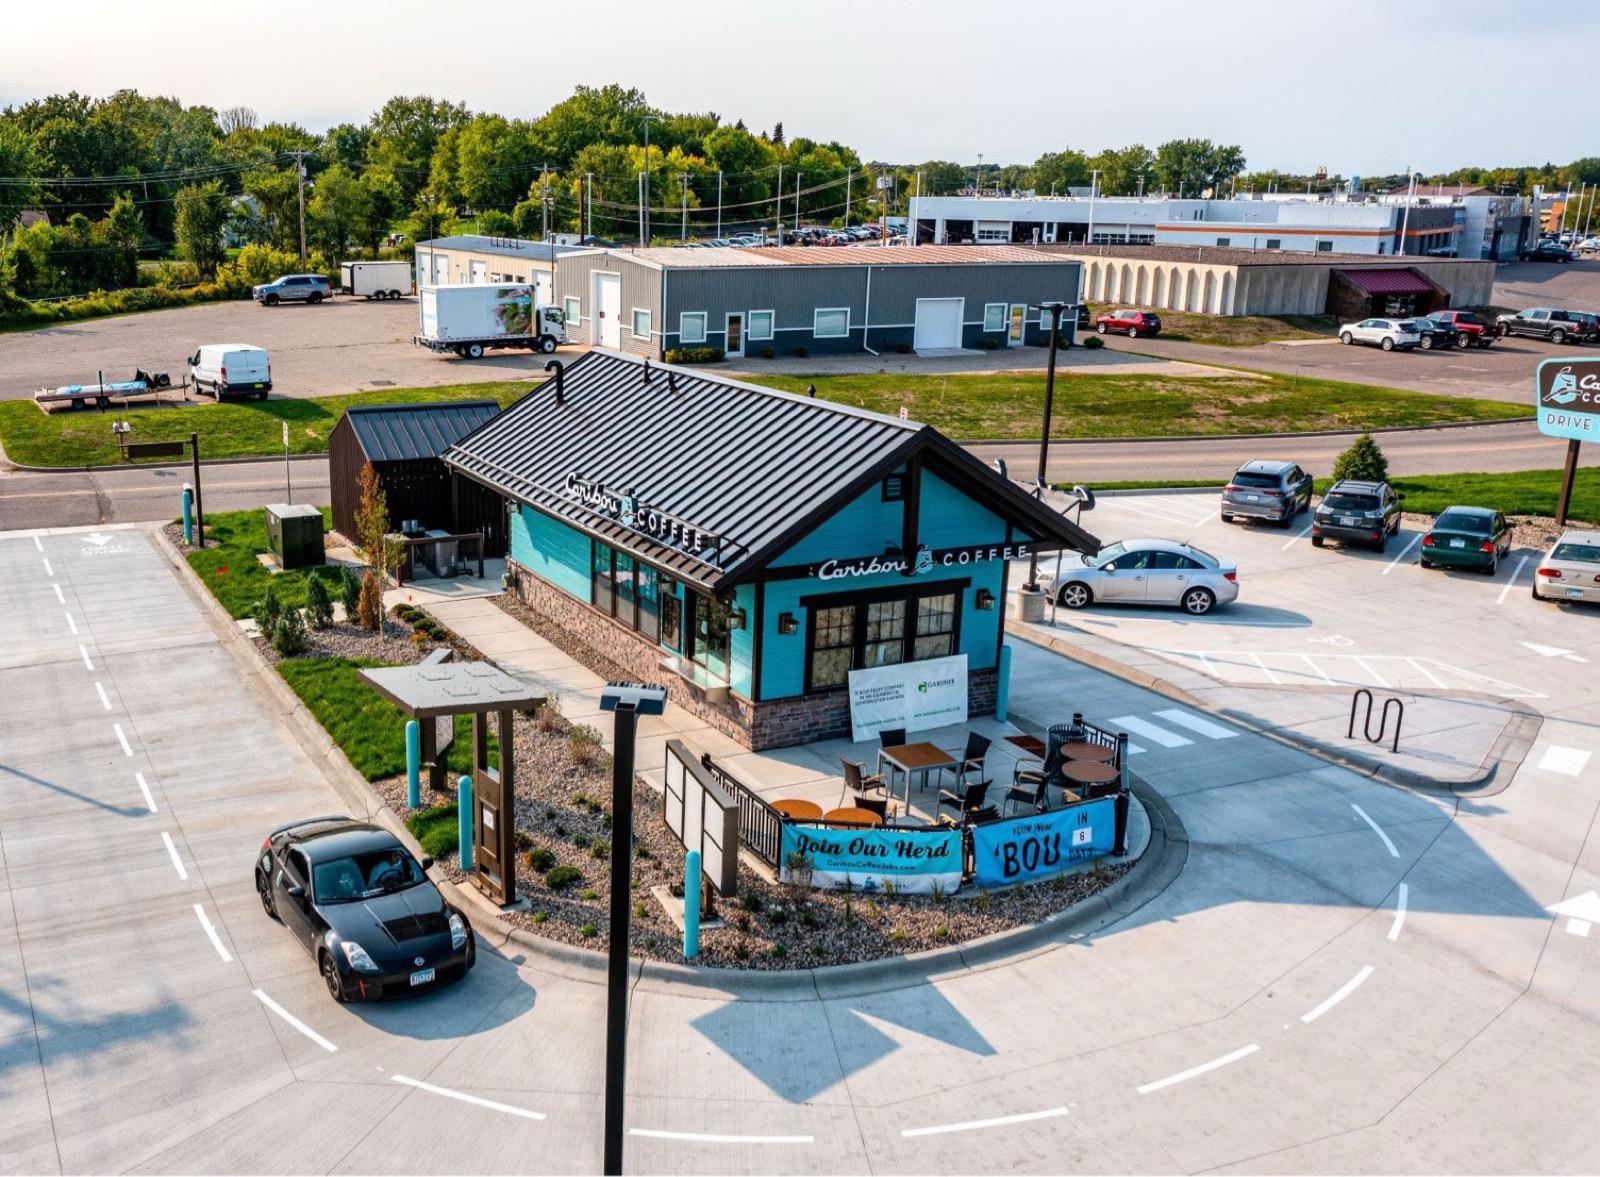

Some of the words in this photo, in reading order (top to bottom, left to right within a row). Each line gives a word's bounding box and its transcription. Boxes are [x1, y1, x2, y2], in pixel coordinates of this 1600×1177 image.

[1547, 413, 1592, 431] DRIVE
[565, 472, 619, 513] Caribou
[637, 509, 702, 551] COFFEE
[818, 557, 909, 580] Caribou
[943, 545, 1027, 567] COFFEE
[927, 678, 955, 688] GARDNER
[1077, 811, 1088, 825] IN
[1079, 831, 1085, 842] 6
[797, 834, 843, 856] Join
[848, 837, 889, 857] Our
[895, 839, 950, 858] Herd
[827, 859, 916, 871] CaribouCoffeeJobs.com
